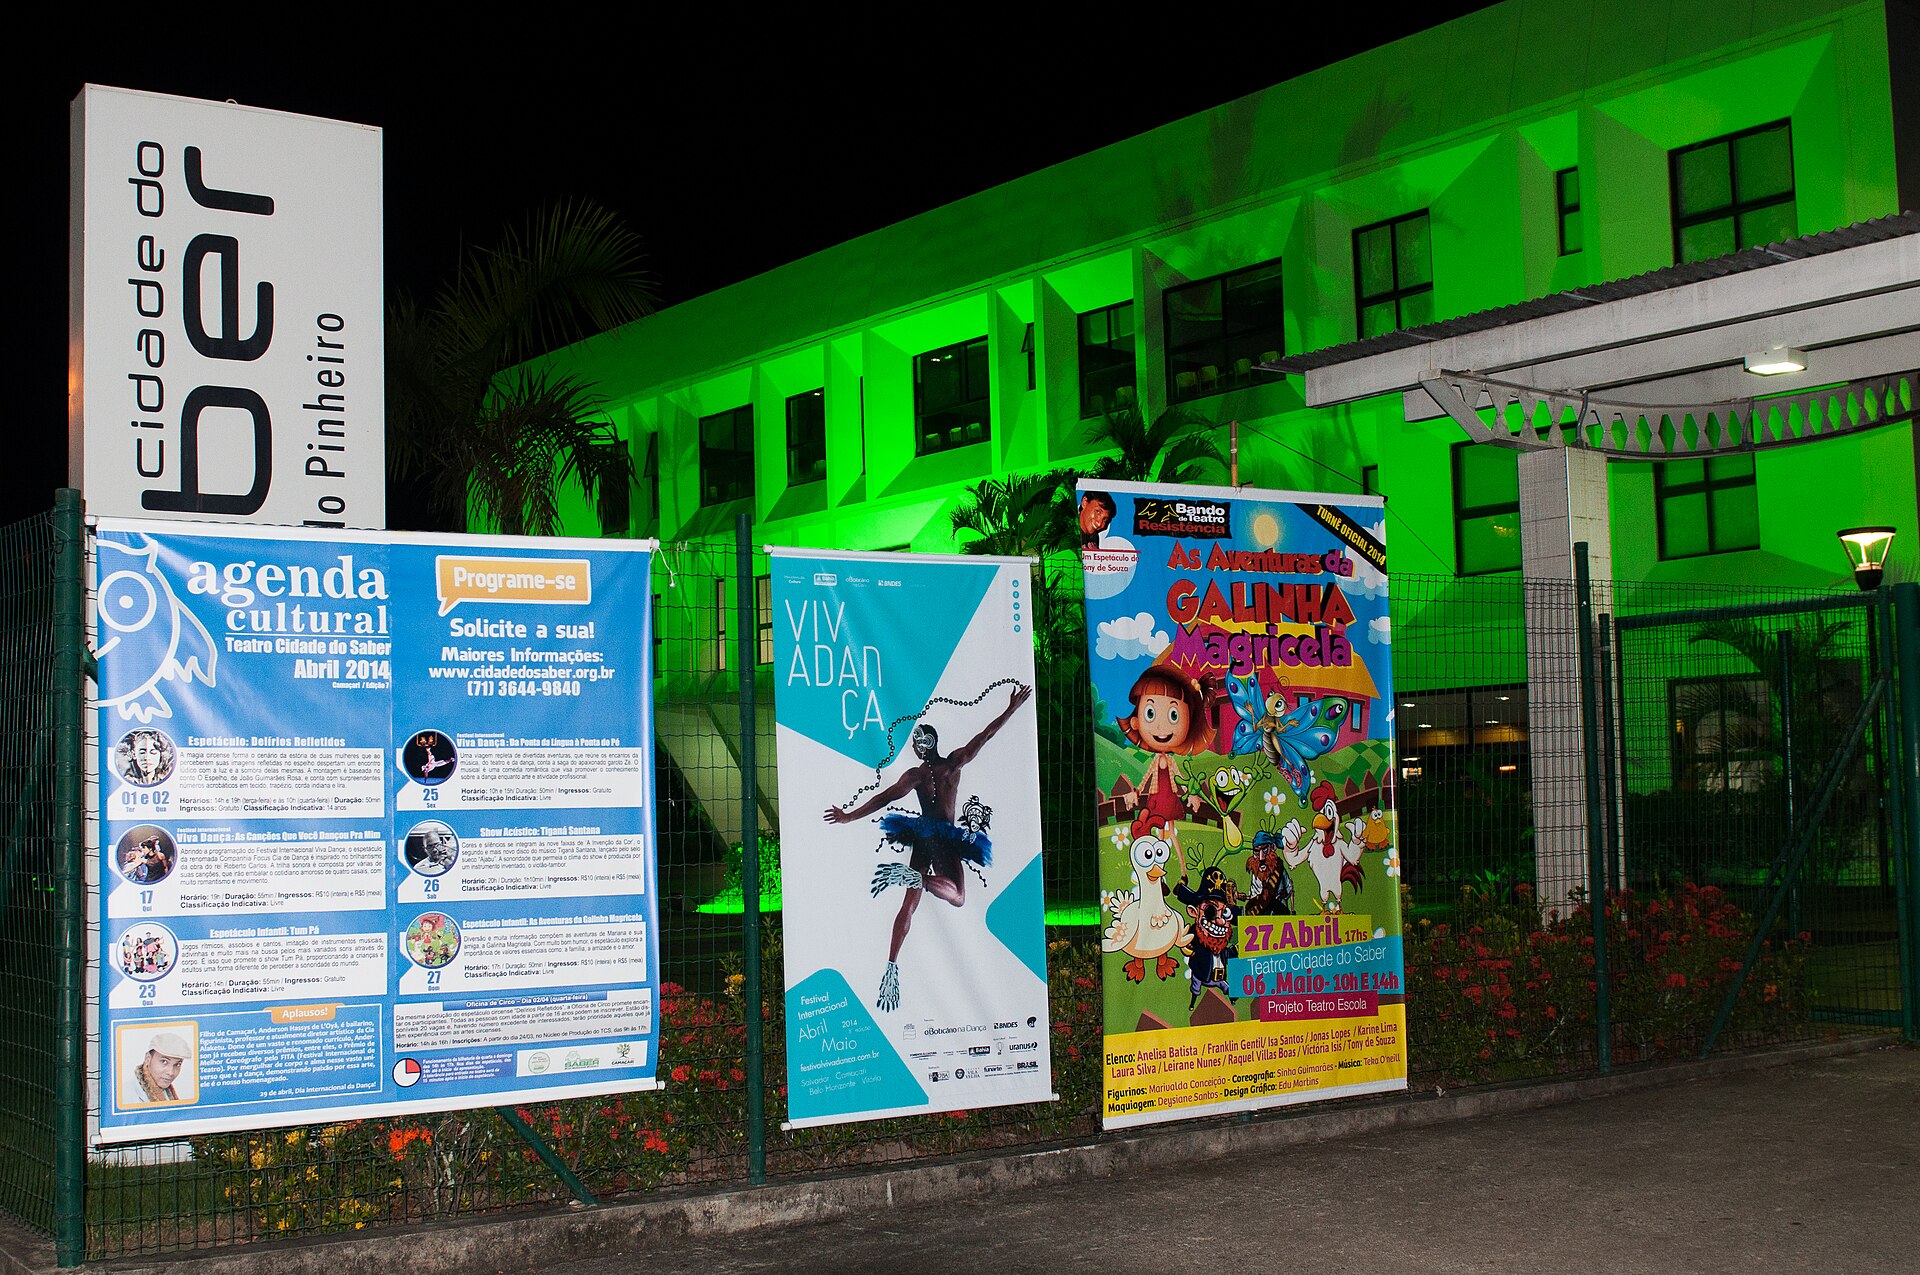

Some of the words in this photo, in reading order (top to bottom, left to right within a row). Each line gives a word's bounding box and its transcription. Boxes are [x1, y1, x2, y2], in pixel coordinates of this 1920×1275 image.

[128, 140, 164, 217] do
[128, 235, 164, 478] cidade
[303, 313, 345, 477] Pinheiro
[1176, 503, 1225, 515] Bando
[1187, 514, 1225, 523] Teatro
[1139, 520, 1225, 534] Resistência
[1317, 505, 1341, 530] TURNÊ
[1340, 525, 1368, 551] OFICIAL
[1367, 545, 1386, 566] 2014
[1094, 553, 1129, 562] Espetáculo
[1167, 540, 1202, 570] As
[1206, 541, 1321, 575] Aventuras
[1322, 550, 1355, 577] da
[1082, 564, 1095, 572] ony
[187, 555, 389, 608] agenda
[454, 567, 575, 593] Programe-se
[1167, 578, 1357, 625] GALINHA
[226, 603, 388, 634] cultural
[785, 600, 845, 642] VIV
[450, 618, 526, 639] Solicite
[536, 624, 547, 639] a
[556, 622, 595, 639] sua!
[225, 638, 272, 653] Teatro
[276, 638, 326, 655] Cidade
[329, 640, 346, 655] do
[350, 640, 391, 655] Saber
[1171, 622, 1354, 678] Magricela
[442, 647, 505, 662] Maiores
[511, 648, 603, 664] Informações:
[295, 659, 339, 679] Abril
[346, 660, 389, 679] 2014
[429, 665, 615, 681] www.cidadedosaber.org.br
[468, 681, 494, 696] (71)
[499, 681, 580, 696] 3644-9840
[842, 690, 885, 739] ÇA
[189, 736, 249, 747] Espetáculo:
[252, 736, 291, 747] Delírios
[294, 736, 345, 747] Refletidos
[122, 791, 137, 805] 01
[140, 793, 148, 805] e
[152, 791, 169, 805] 02
[423, 789, 439, 802] 25
[480, 828, 501, 837] Show
[568, 826, 600, 835] Santana
[424, 880, 440, 892] 26
[548, 875, 579, 883] Ingressos:
[462, 884, 504, 892] Classificação
[140, 891, 153, 904] 17
[210, 927, 256, 938] Espetáculo
[290, 926, 307, 936] Tum
[1345, 929, 1367, 942] 17hs
[1248, 958, 1286, 975] Teatro
[1291, 953, 1333, 970] Cidade
[1337, 949, 1351, 964] do
[1355, 946, 1386, 962] Saber
[428, 971, 441, 983] 27
[1243, 974, 1265, 995] 06
[1334, 973, 1358, 990] 10h
[1361, 973, 1369, 990] E
[1372, 972, 1399, 990] 14h
[139, 985, 156, 998] 23
[801, 992, 829, 1005] Festival
[282, 1007, 328, 1020] Aplausos!
[798, 997, 848, 1020] Internacional
[1269, 1001, 1303, 1015] Projeto
[1306, 999, 1335, 1011] Teatro
[1338, 998, 1367, 1010] Escola
[799, 1018, 827, 1042] Abril
[842, 1020, 857, 1028] 2014
[822, 1037, 857, 1052] Maio
[1106, 1053, 1135, 1065] Elenco:
[1137, 1048, 1166, 1061] Anelisa
[1169, 1044, 1198, 1057] Batista
[1208, 1040, 1238, 1054] Franklin
[1268, 1036, 1278, 1047] Isa
[1280, 1035, 1304, 1045] Santos
[1310, 1031, 1329, 1042] Jonas
[1331, 1029, 1350, 1040] Lopes
[1381, 1023, 1397, 1033] Lima
[1112, 1067, 1134, 1078] Laura
[1137, 1063, 1156, 1075] Silva
[1164, 1060, 1194, 1072] Leirane
[1197, 1057, 1220, 1068] Nunes
[1229, 1051, 1254, 1066] Raquel
[1256, 1049, 1276, 1061] Villas
[1279, 1047, 1295, 1058] Boas
[1302, 1043, 1329, 1055] Victória
[1332, 1042, 1341, 1052] Isis
[1347, 1039, 1363, 1050] Tony
[1365, 1037, 1373, 1047] de
[1376, 1035, 1395, 1045] Souza
[801, 1076, 829, 1087] Salvador
[1108, 1087, 1147, 1101] Figurinos:
[1190, 1076, 1226, 1089] Conceição
[1232, 1070, 1276, 1084] Coreografia:
[1298, 1063, 1333, 1075] Guimarães
[1338, 1059, 1362, 1069] Música:
[277, 1087, 293, 1096] abril,
[306, 1084, 346, 1093] Internacional
[810, 1088, 823, 1096] Belo
[826, 1081, 856, 1092] Horizonte
[1108, 1100, 1156, 1113] Maquiagem:
[1158, 1093, 1192, 1107] Deysiane
[1195, 1091, 1218, 1102] Santos
[1224, 1086, 1248, 1099] Design
[1251, 1083, 1277, 1094] Gráfico:
[1279, 1080, 1291, 1090] Edu
[1293, 1077, 1318, 1087] Martins
